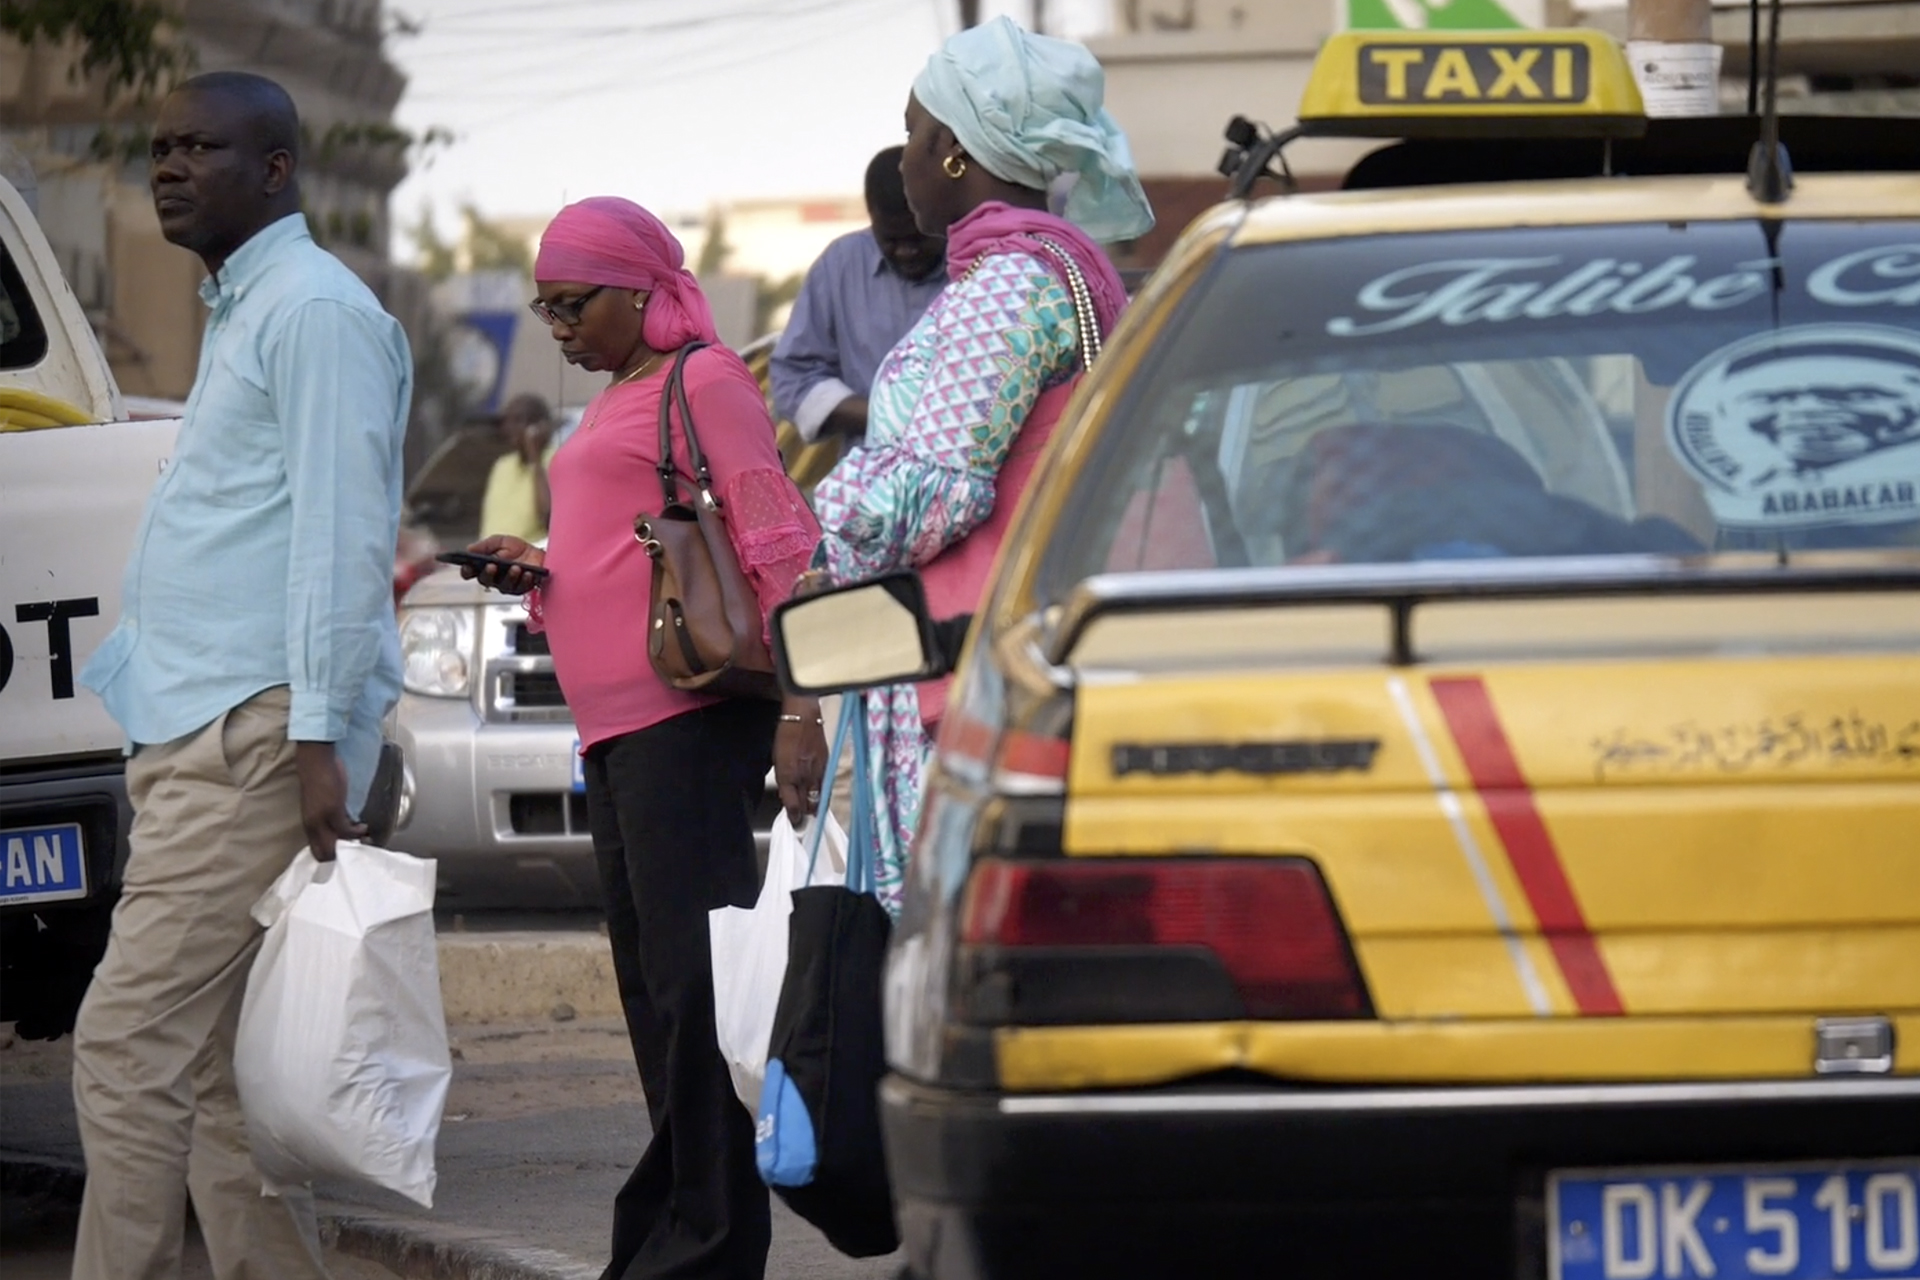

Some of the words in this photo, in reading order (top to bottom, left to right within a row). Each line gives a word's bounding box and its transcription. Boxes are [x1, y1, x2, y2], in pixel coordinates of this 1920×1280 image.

[1370, 48, 1574, 98] TAXI
[1326, 254, 1781, 336] Talibé
[0, 597, 99, 700] T
